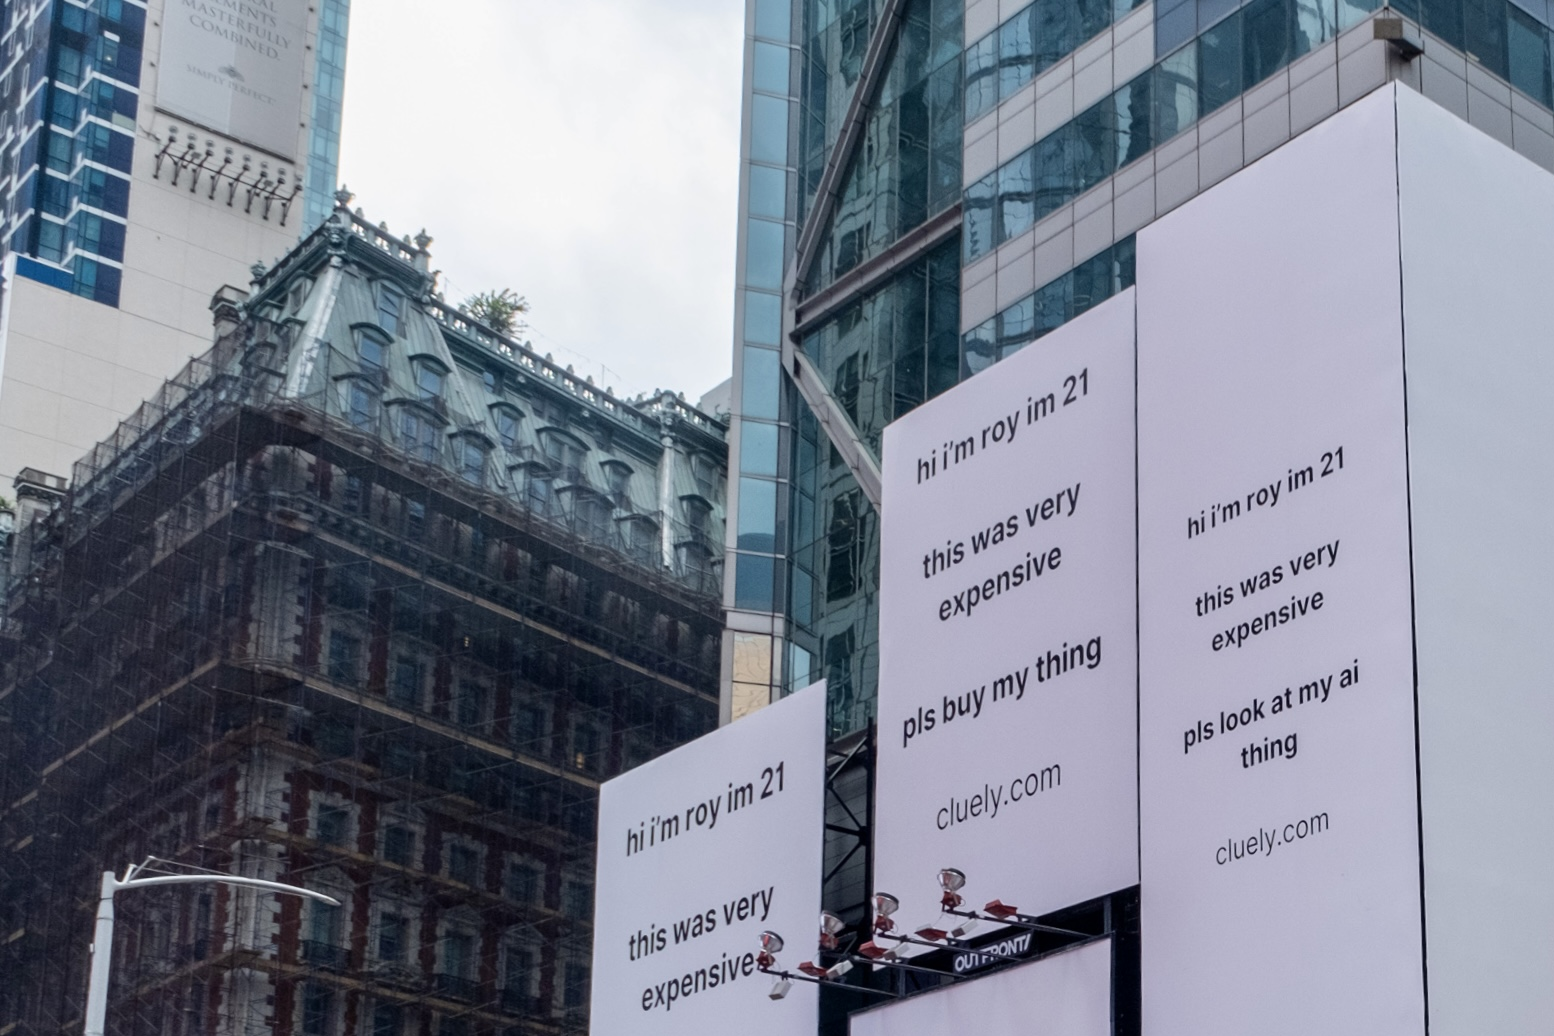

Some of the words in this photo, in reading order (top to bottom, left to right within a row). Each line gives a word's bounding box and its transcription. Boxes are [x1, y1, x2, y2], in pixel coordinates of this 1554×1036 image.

[918, 449, 936, 484] hi
[943, 437, 974, 470] i'm
[982, 411, 1020, 449] roy
[1028, 393, 1054, 425] im
[1063, 368, 1087, 406] 21
[1188, 510, 1205, 539] hi
[1212, 500, 1240, 528] i'm
[1247, 480, 1281, 511] roy
[1288, 466, 1313, 493] im
[1321, 446, 1343, 477] 21
[923, 540, 964, 579] this
[971, 515, 1018, 554] was
[1026, 483, 1080, 527] very
[939, 547, 1061, 621] expensive
[1196, 585, 1234, 617] this
[1240, 566, 1283, 597] was
[1289, 540, 1339, 576] very
[1212, 592, 1323, 651] expensive
[903, 707, 935, 748] pls
[943, 686, 985, 723] buy
[993, 667, 1029, 702] my
[1036, 636, 1101, 683] thing
[1184, 720, 1214, 754] pls
[1220, 699, 1265, 734] look
[1271, 688, 1292, 714] at
[1299, 675, 1333, 704] my
[1340, 659, 1358, 688] ai
[1241, 733, 1297, 768] thing
[627, 822, 644, 856] hi
[650, 815, 679, 846] i'm
[686, 796, 721, 831] roy
[728, 783, 753, 813] im
[761, 761, 784, 799] 21
[937, 764, 1061, 830] cluely.com
[1216, 813, 1328, 865] cluely.com
[629, 924, 666, 961] this
[673, 909, 716, 944] was
[723, 887, 774, 925] very
[641, 950, 756, 1011] expensive
